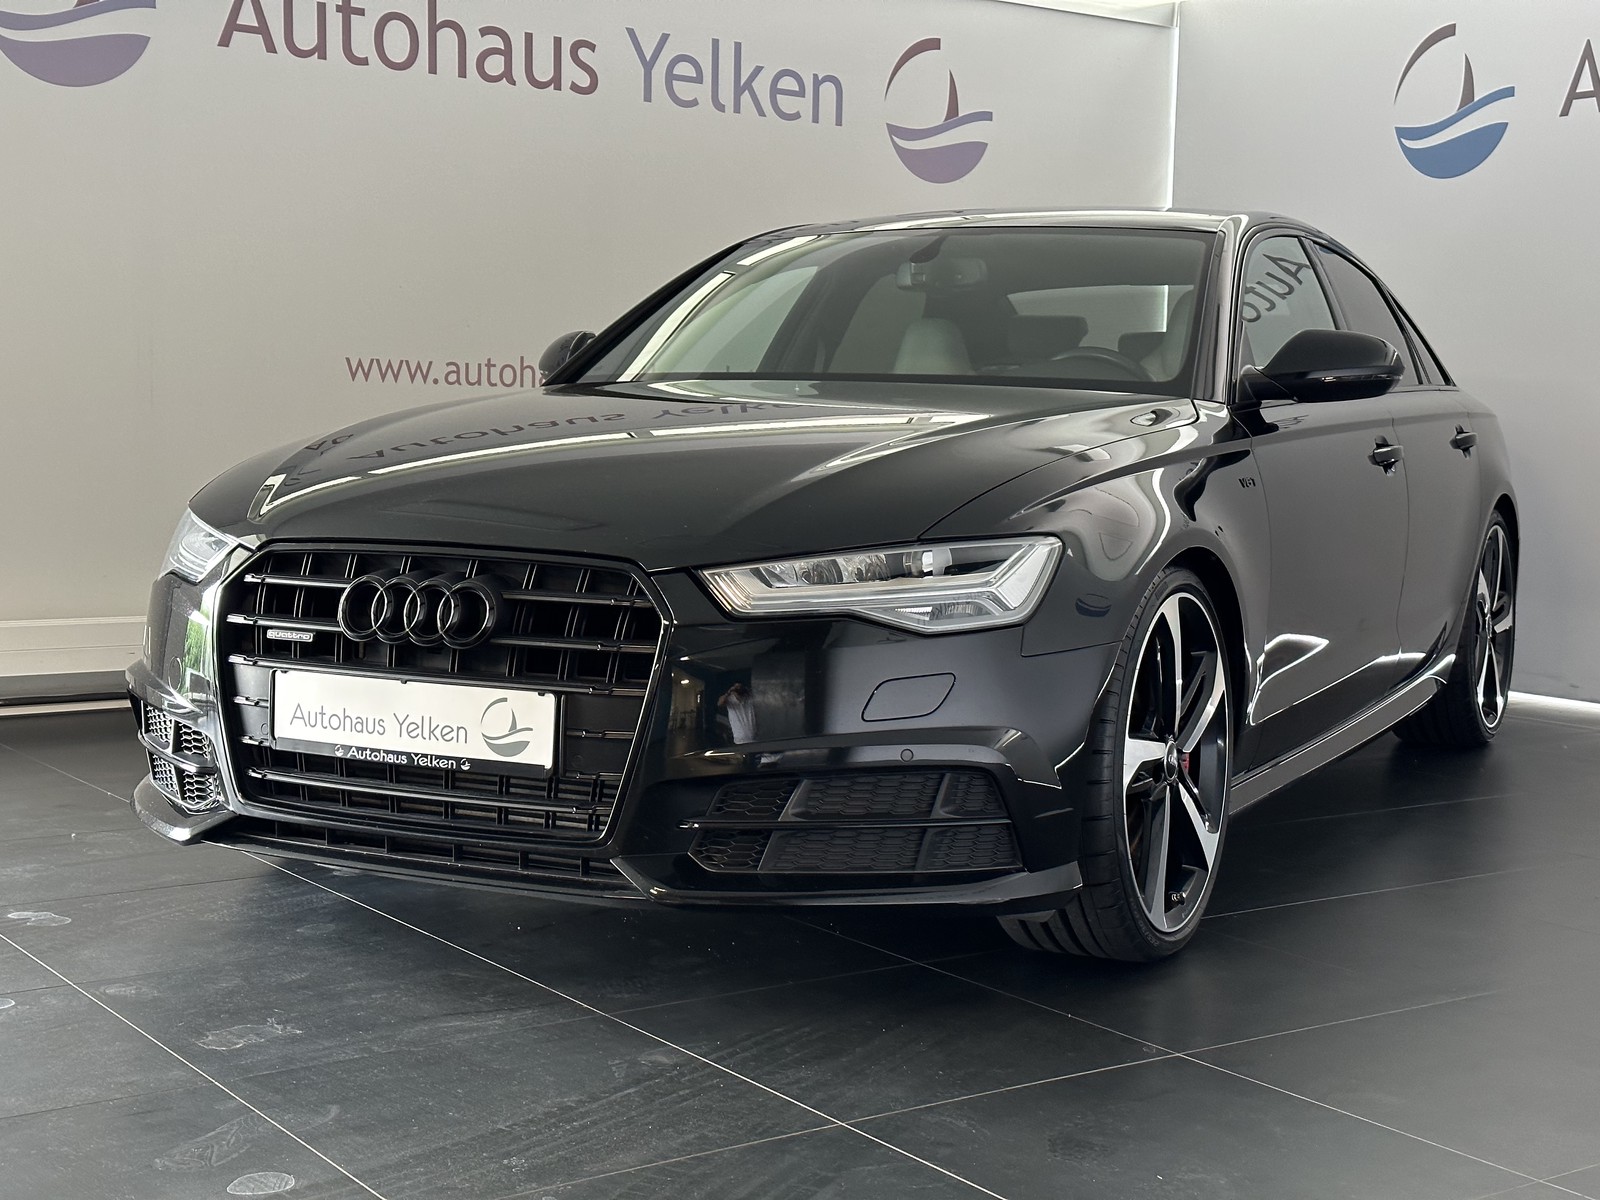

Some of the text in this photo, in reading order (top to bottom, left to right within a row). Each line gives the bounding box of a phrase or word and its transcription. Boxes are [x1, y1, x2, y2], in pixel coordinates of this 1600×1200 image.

[216, 0, 845, 128] Autohaus Yelken
[344, 356, 546, 388] www.autoh
[268, 630, 312, 641] quattro
[290, 702, 468, 744] Autohaus Yelken
[347, 746, 456, 770] Autohaus Yelken
